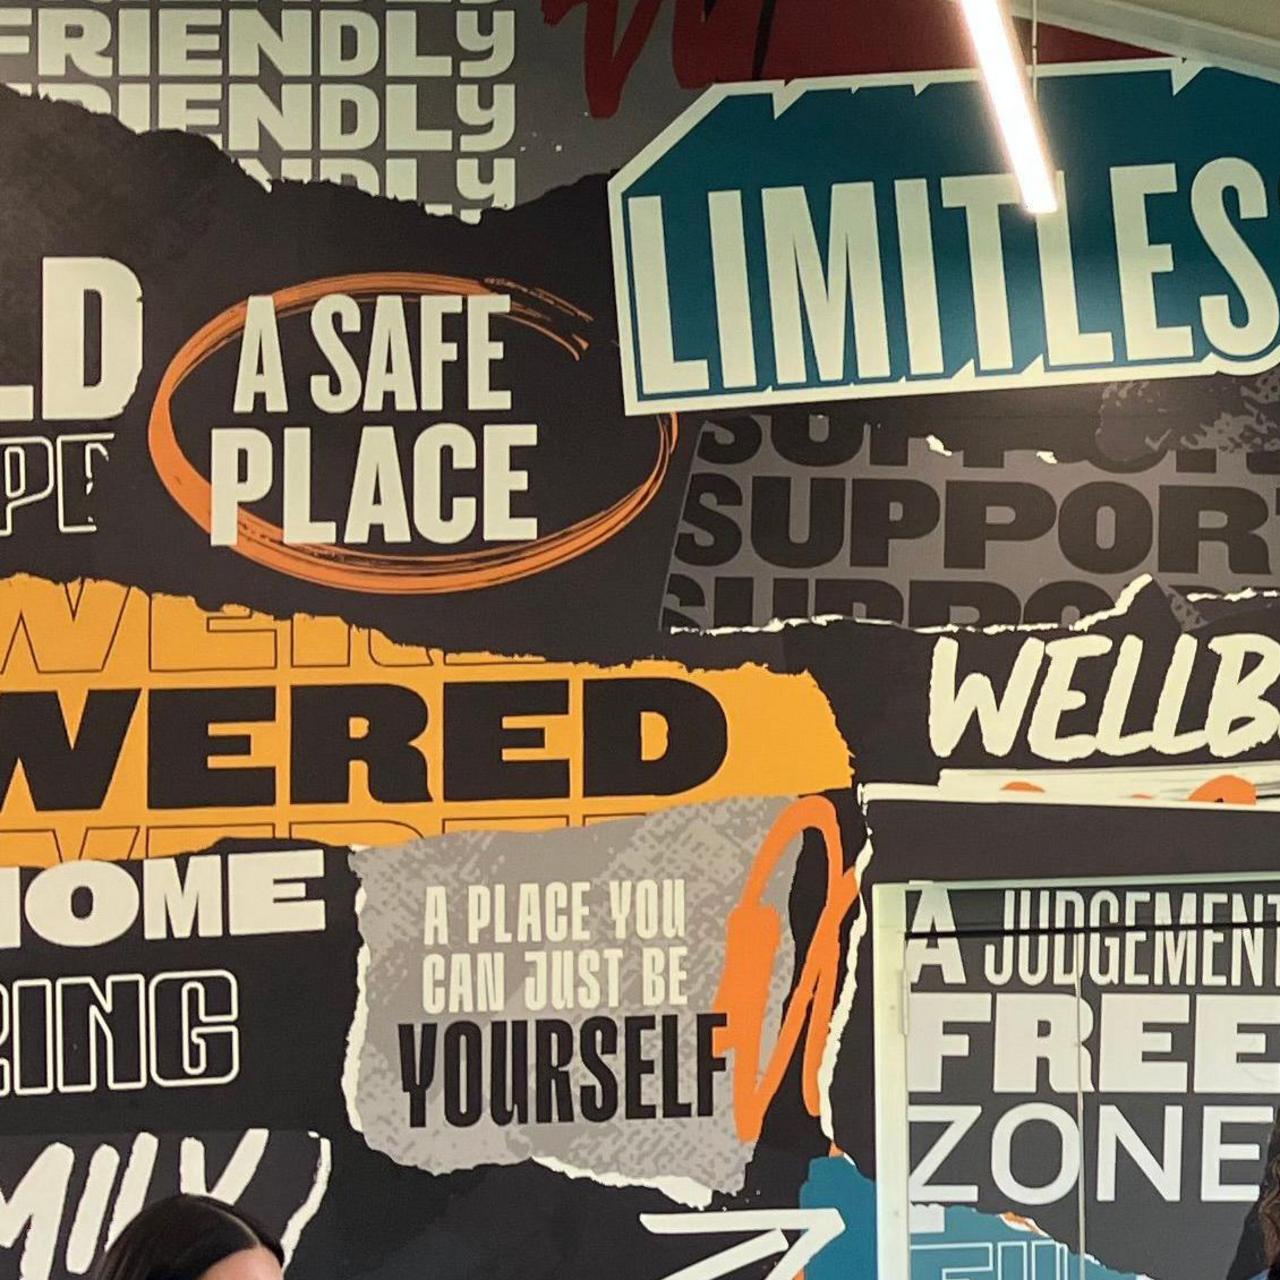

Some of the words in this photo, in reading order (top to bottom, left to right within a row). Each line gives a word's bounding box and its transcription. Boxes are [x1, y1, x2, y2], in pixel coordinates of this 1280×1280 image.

[233, 295, 288, 413] A
[310, 293, 512, 412] SAFE
[210, 423, 538, 546] PLACE
[0, 849, 326, 949] OME
[425, 885, 448, 945] A
[467, 881, 591, 944] PLACE
[608, 878, 686, 940] YOU
[906, 888, 967, 985] A
[422, 952, 505, 1014] CAN
[524, 948, 623, 1012] JUST
[642, 946, 689, 1006] BE
[0, 968, 240, 1096] ING
[397, 1013, 728, 1128] YOURSELF
[908, 1103, 1276, 1203] ZONE
